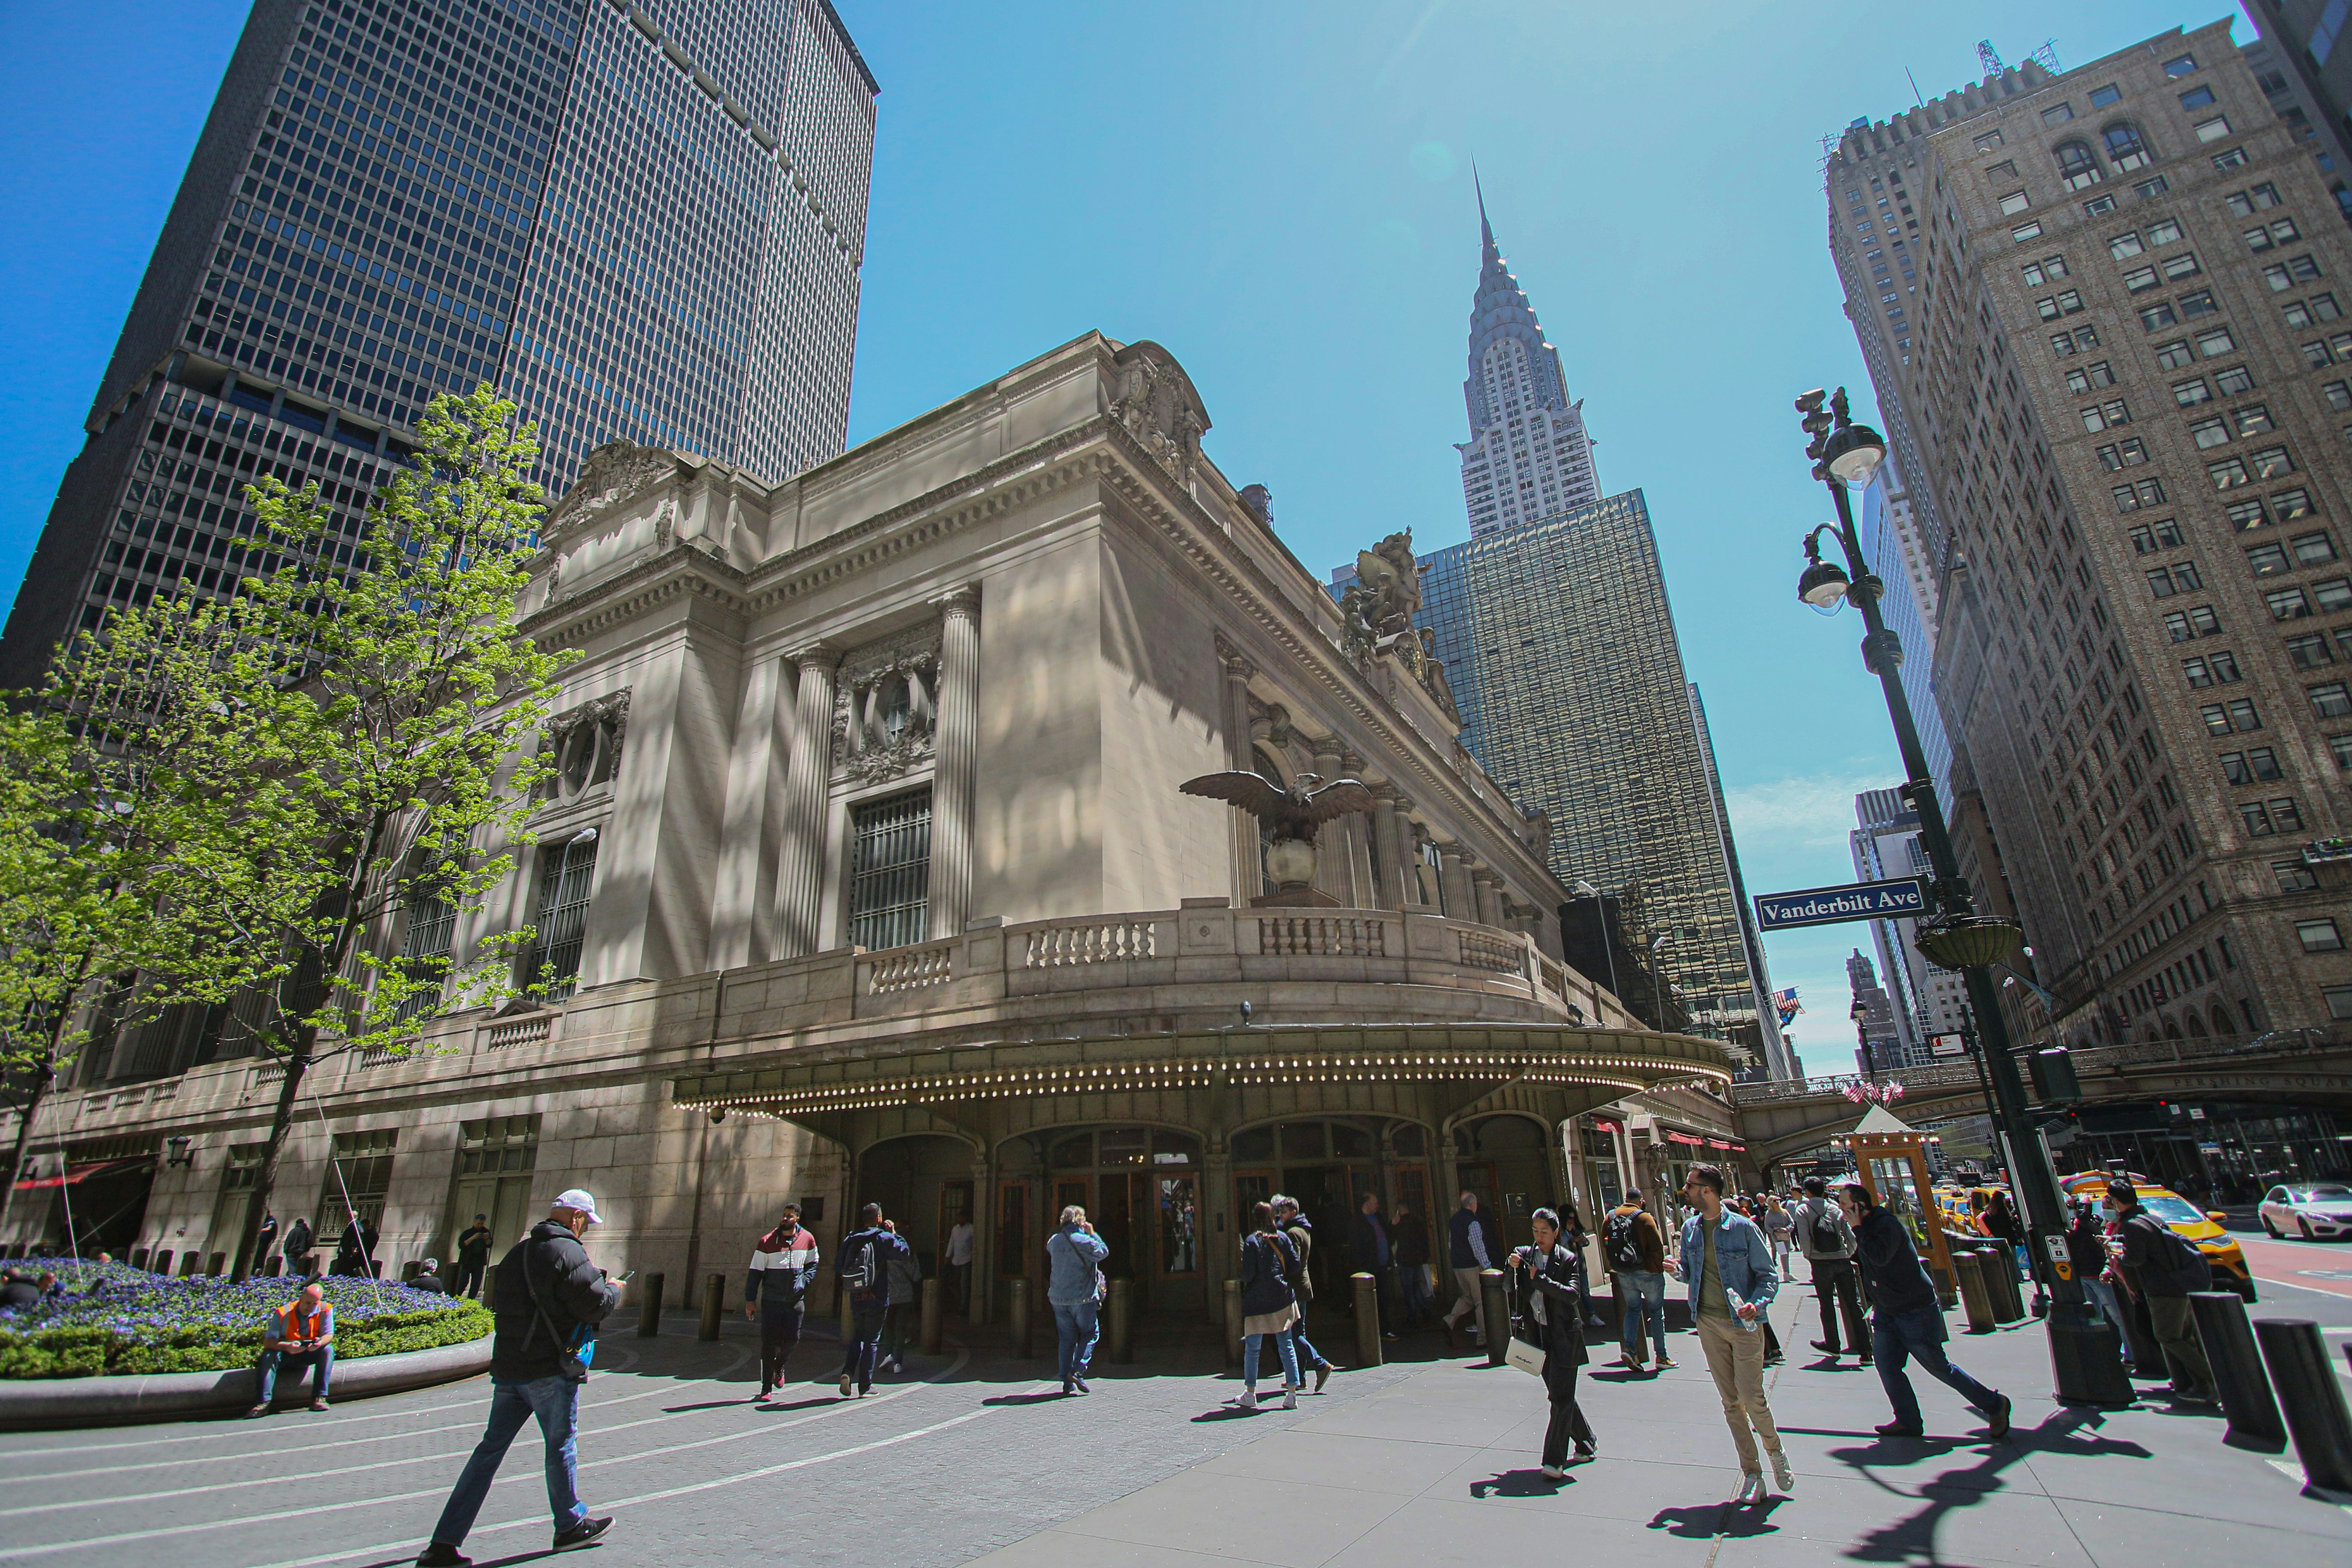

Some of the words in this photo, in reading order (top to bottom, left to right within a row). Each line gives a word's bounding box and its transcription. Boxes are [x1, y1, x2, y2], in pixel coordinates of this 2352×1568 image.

[1763, 894, 1873, 920] Vanderbilt
[1878, 891, 1919, 908] Ave
[2174, 1077, 2269, 1086] PERSHING
[1907, 1099, 1977, 1118] CENTRAL
